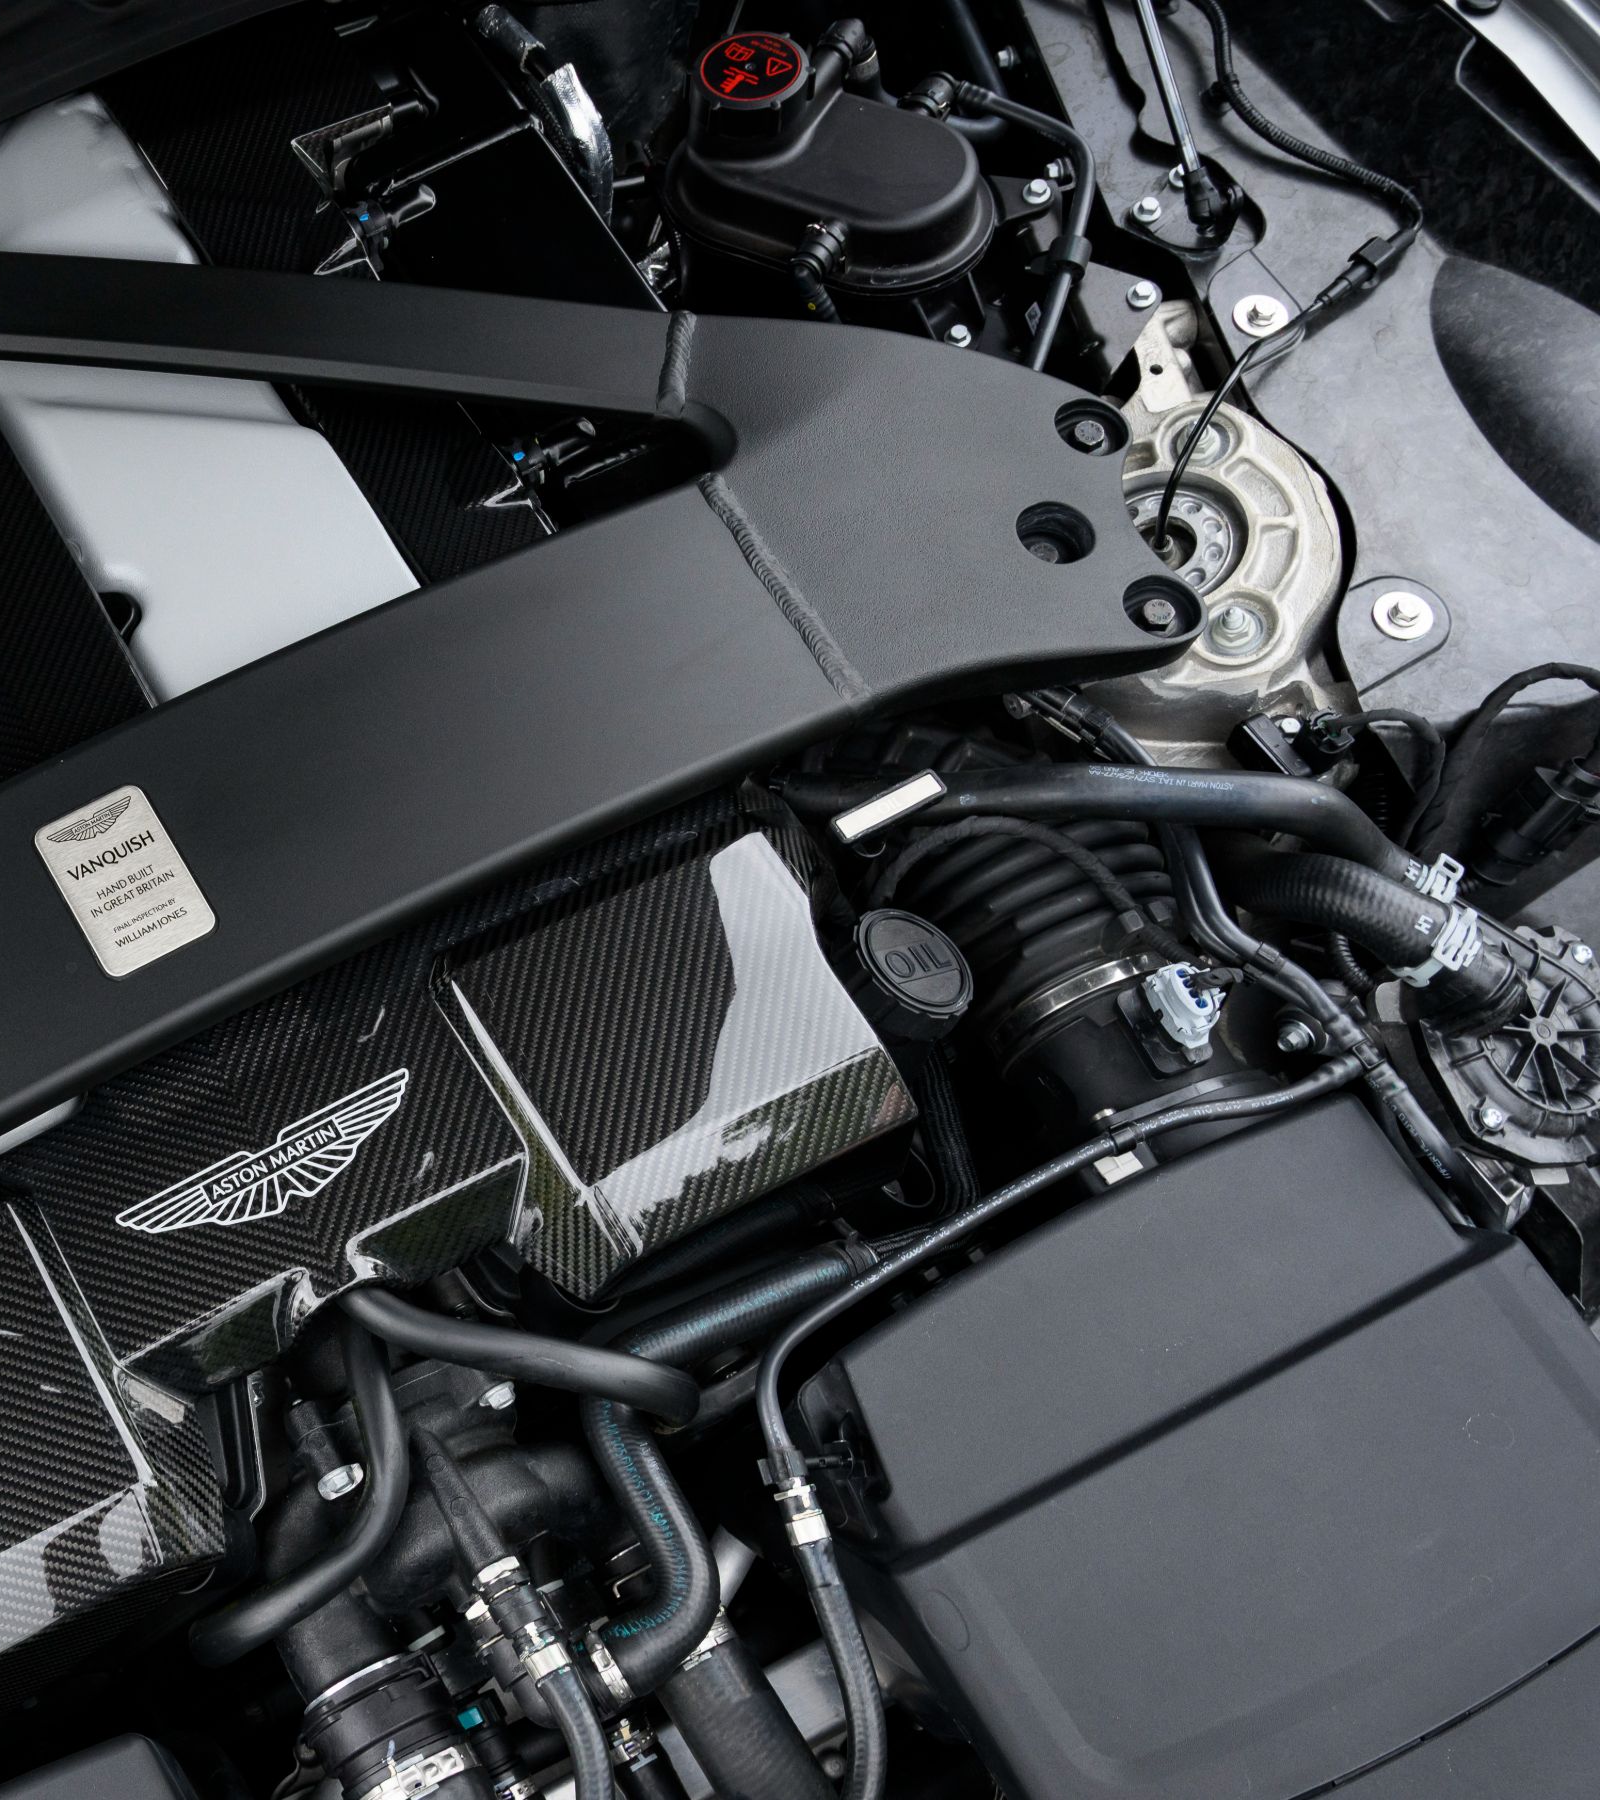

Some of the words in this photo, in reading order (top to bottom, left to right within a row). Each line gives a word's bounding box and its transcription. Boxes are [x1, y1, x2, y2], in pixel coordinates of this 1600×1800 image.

[73, 821, 91, 834] ASTON
[89, 811, 111, 825] MARTIN
[66, 830, 155, 880] VANQUISH
[90, 906, 103, 918] IN
[103, 889, 135, 911] GREAT
[135, 870, 175, 895] BRITAIN
[96, 879, 127, 900] HAND
[127, 864, 154, 884] BUILT
[112, 920, 133, 934] FINAL
[131, 901, 169, 925] INSPECTION
[167, 897, 177, 906] BY
[115, 921, 158, 949] WILLIAM
[156, 906, 188, 928] JONES
[884, 942, 952, 979] OIL
[212, 1160, 268, 1200] ASTON
[269, 1125, 336, 1169] MARTIN
